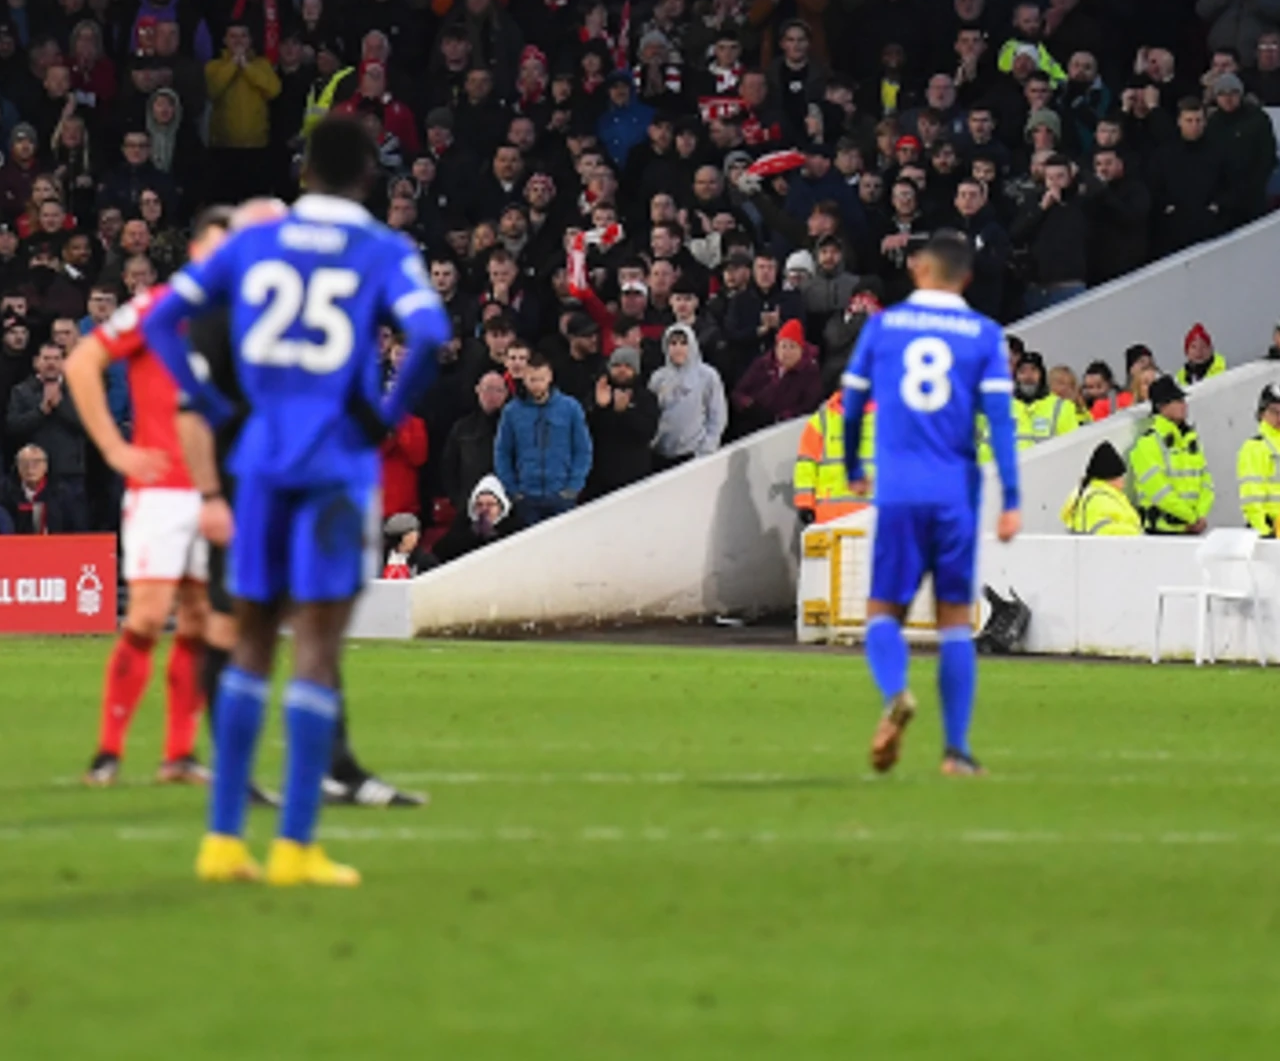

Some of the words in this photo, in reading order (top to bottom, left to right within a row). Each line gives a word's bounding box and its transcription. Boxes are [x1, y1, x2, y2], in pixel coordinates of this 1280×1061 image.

[241, 259, 359, 373] 25
[900, 336, 954, 413] 8
[16, 577, 67, 604] CLUB
